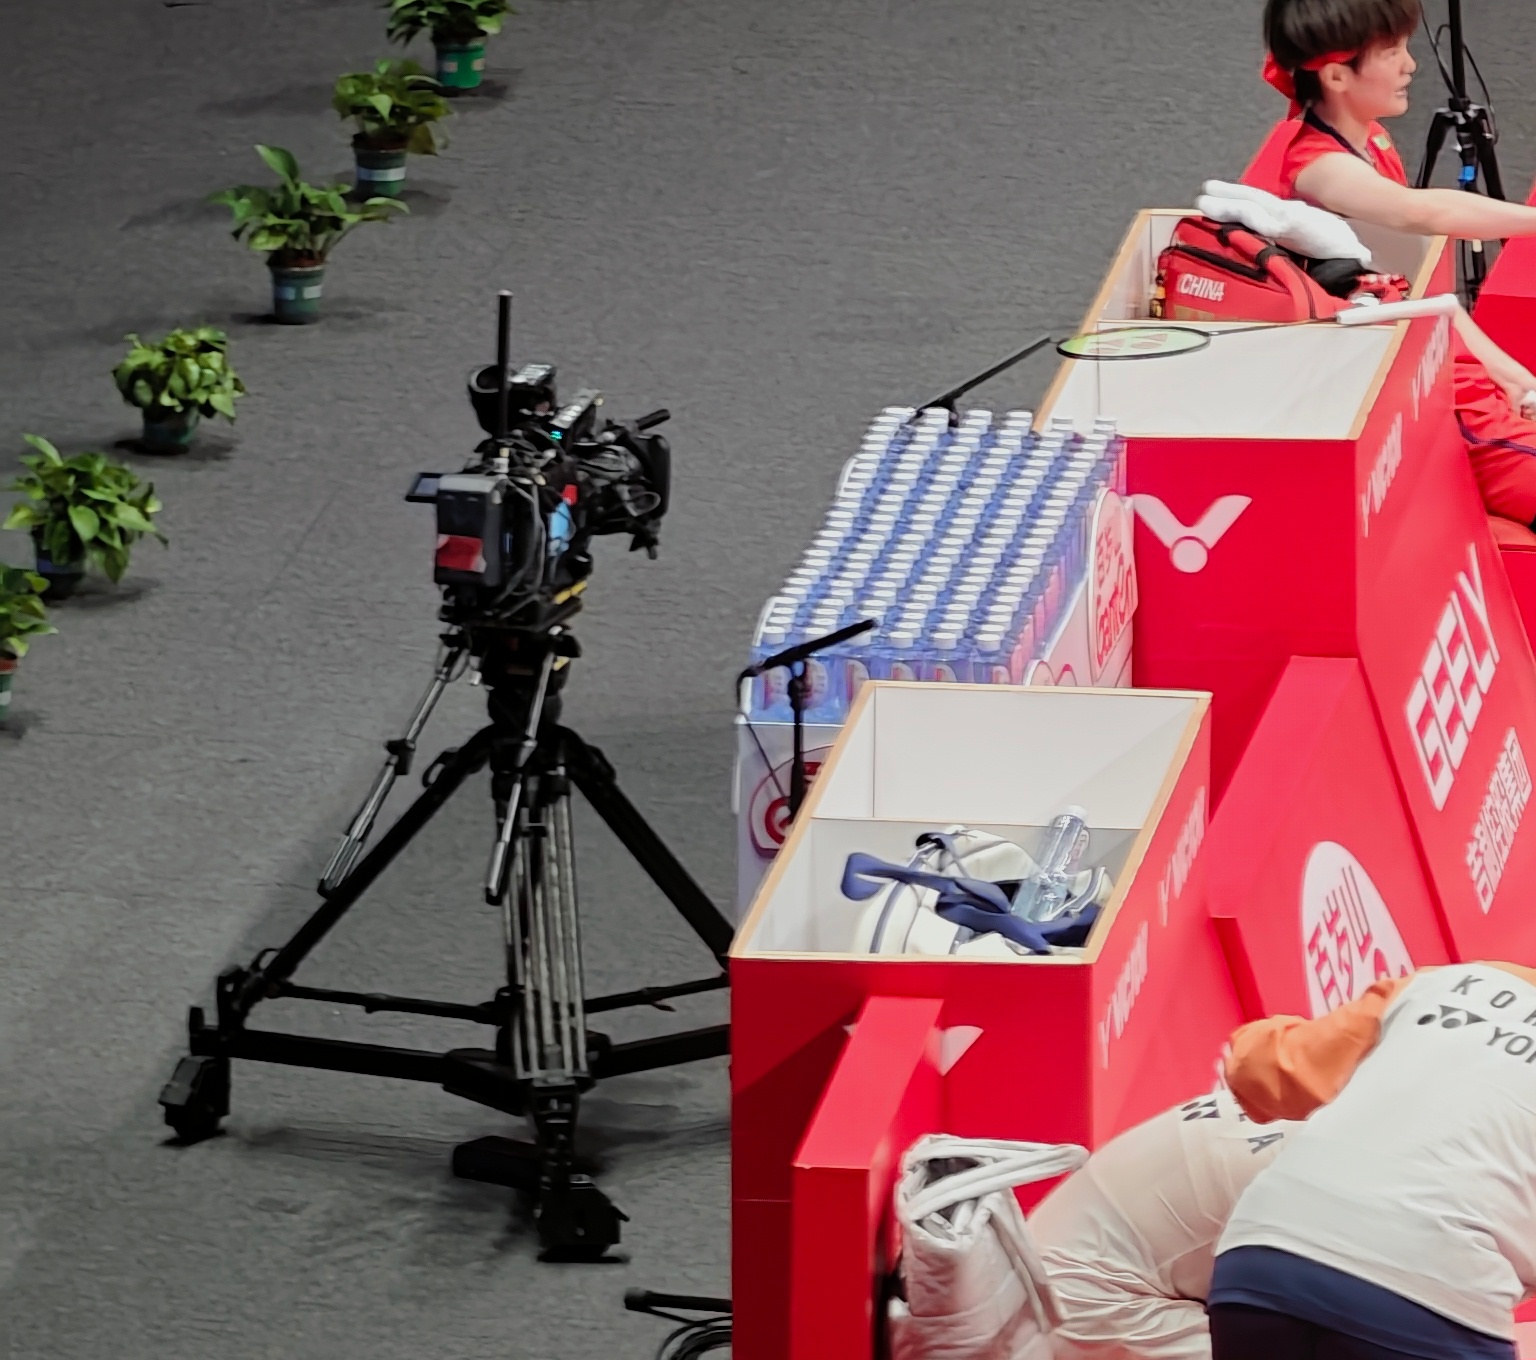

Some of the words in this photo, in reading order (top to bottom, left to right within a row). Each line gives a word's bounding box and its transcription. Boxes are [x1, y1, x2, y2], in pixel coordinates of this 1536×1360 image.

[1179, 273, 1225, 302] CHINA
[1405, 542, 1500, 812] GEELY
[1466, 727, 1533, 915] 吉利控股集团
